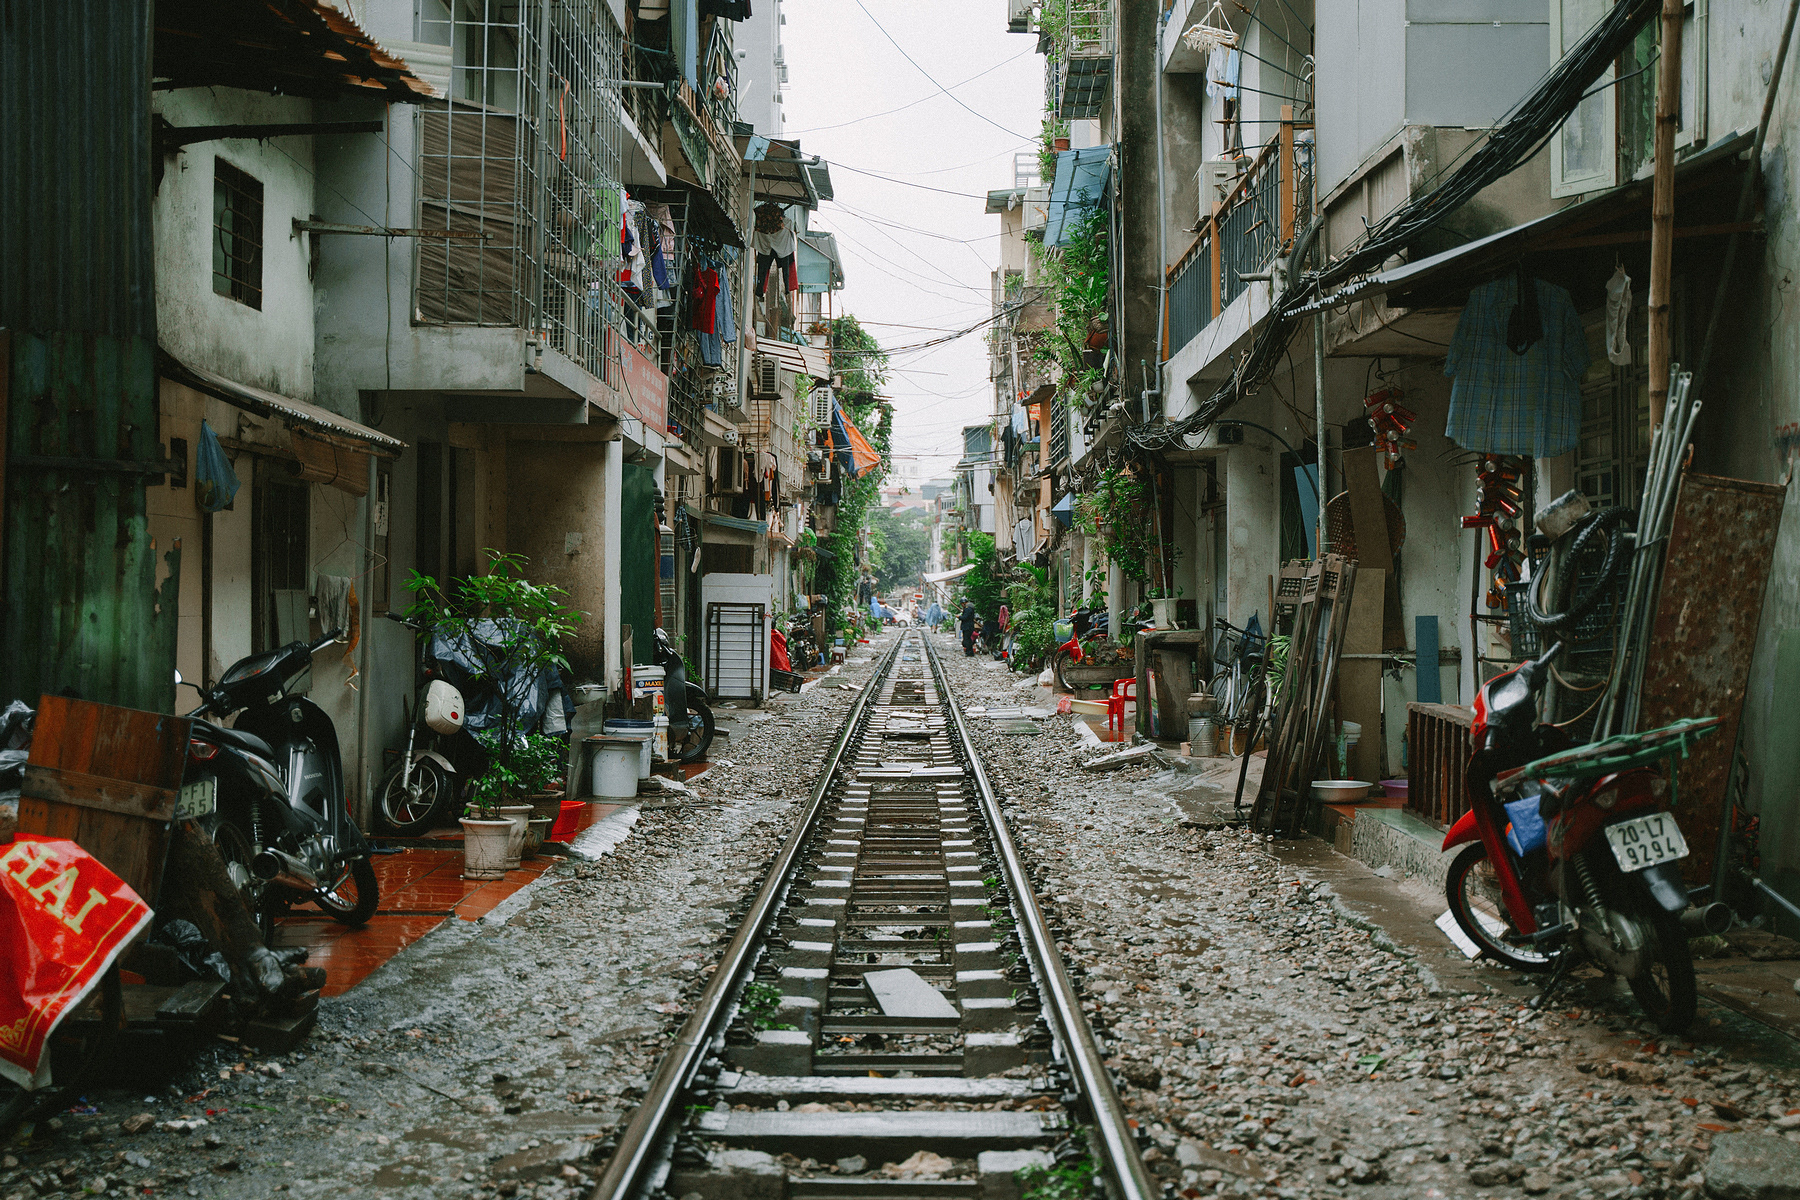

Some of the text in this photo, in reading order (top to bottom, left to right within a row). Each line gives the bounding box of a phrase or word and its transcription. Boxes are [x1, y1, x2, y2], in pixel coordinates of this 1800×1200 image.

[304, 772, 322, 780] HONDA
[180, 781, 206, 801] -F1
[1617, 816, 1664, 847] 20-L7
[1625, 836, 1677, 865] 9294
[0, 841, 109, 935] HAI
